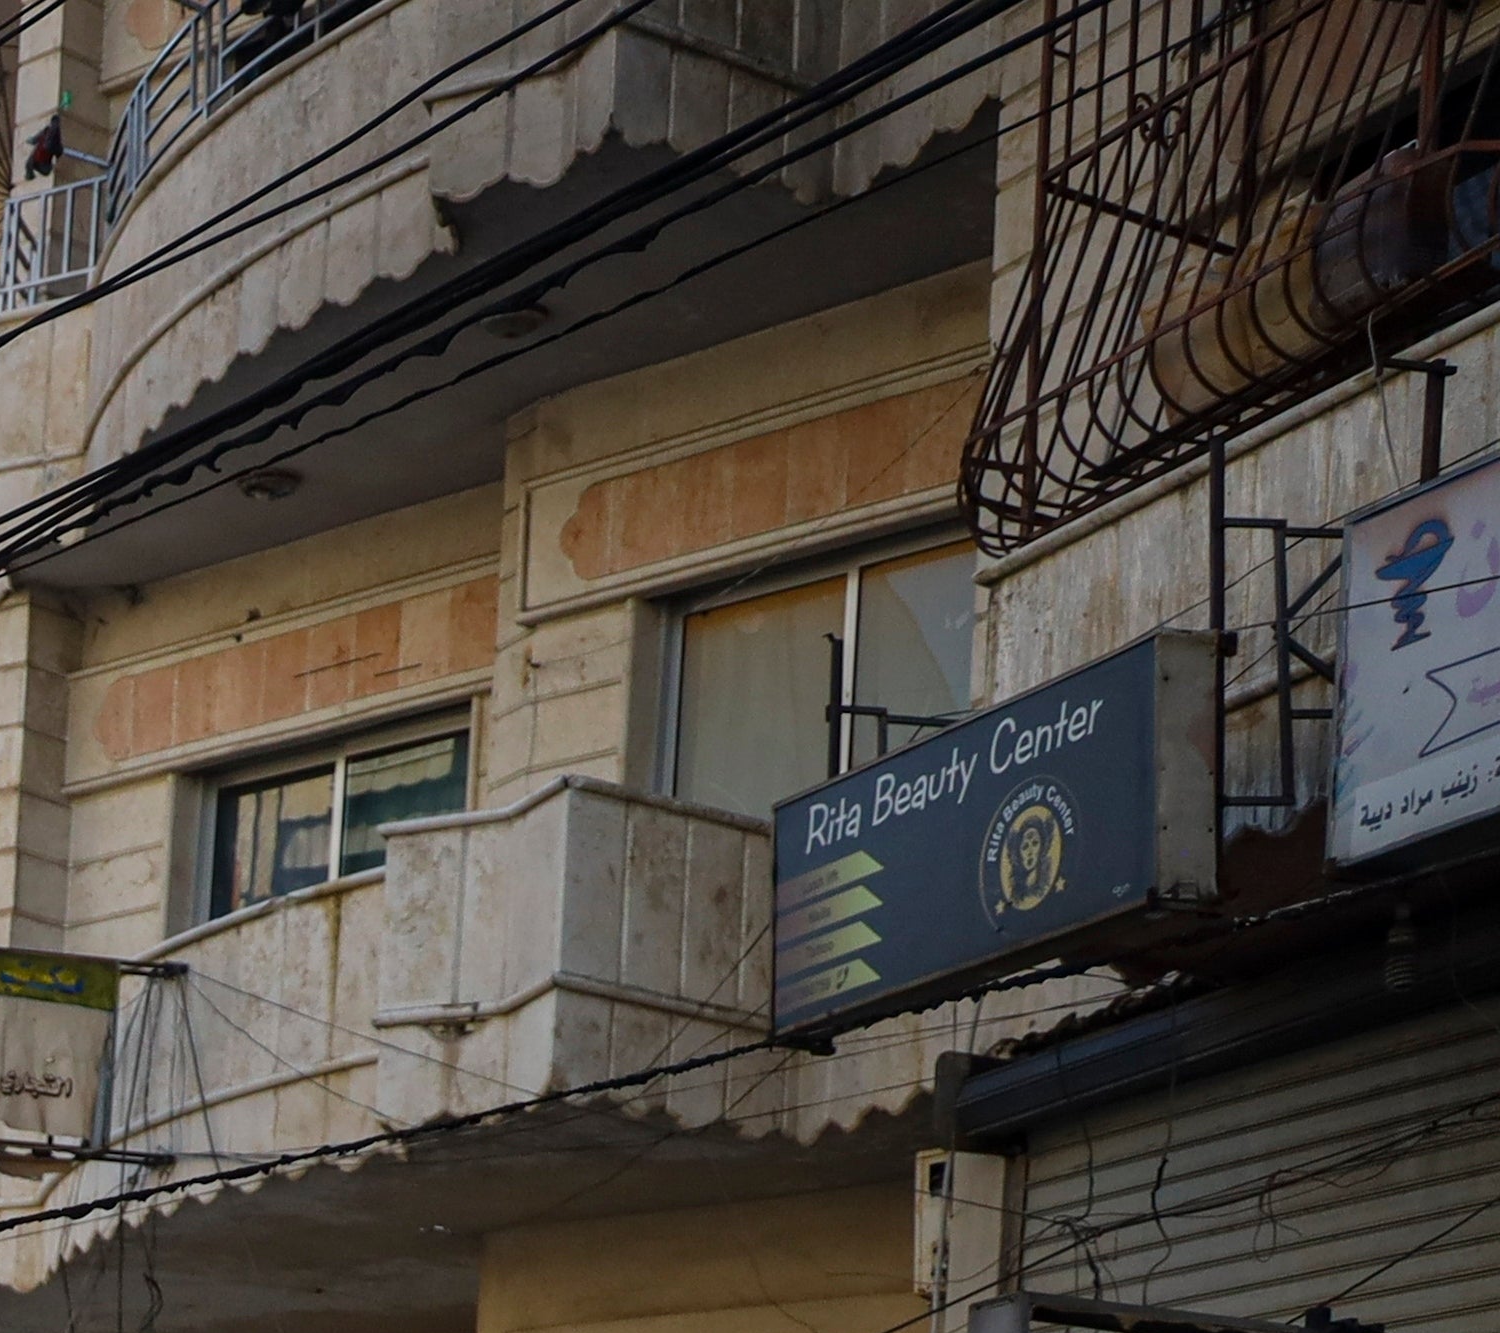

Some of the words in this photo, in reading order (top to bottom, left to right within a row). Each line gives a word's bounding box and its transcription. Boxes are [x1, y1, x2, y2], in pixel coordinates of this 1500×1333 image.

[805, 798, 862, 854] Rita
[871, 746, 979, 828] Beauty
[989, 697, 1104, 774] Center
[1400, 787, 1434, 815] مراد
[1440, 763, 1479, 805] زينب
[986, 821, 1005, 862] Rita
[1002, 783, 1045, 823] Beauty
[1046, 785, 1075, 836] Center
